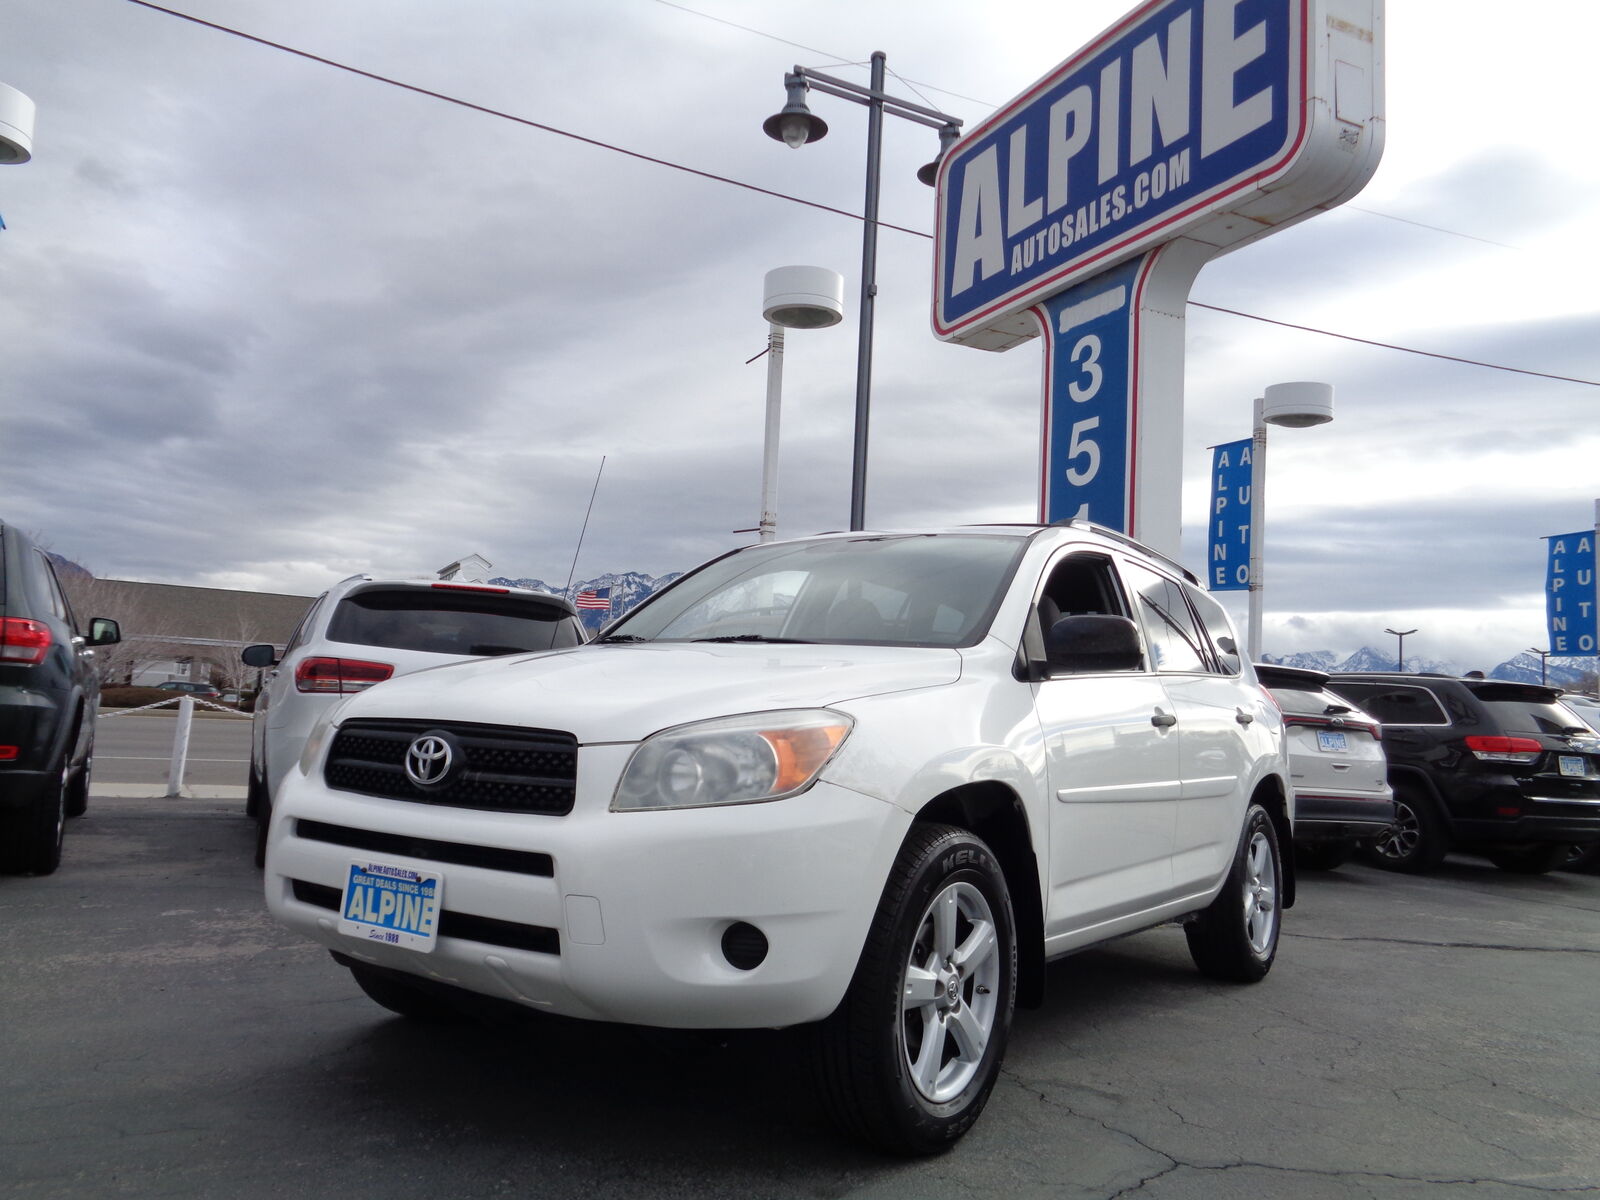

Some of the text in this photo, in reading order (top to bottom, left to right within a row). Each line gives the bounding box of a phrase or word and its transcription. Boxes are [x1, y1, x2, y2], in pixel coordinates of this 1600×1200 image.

[952, 0, 1272, 298] ALPINE
[1011, 148, 1190, 276] AUTOSALES.COM
[1213, 451, 1230, 585] ALPINE
[1236, 447, 1252, 584] AUTO
[1552, 540, 1567, 651] ALPINE
[1577, 537, 1594, 651] AUTO
[347, 885, 435, 934] ALPINE
[353, 874, 375, 886] GREAT
[375, 878, 397, 890] DEALS
[398, 882, 419, 895] SINCE
